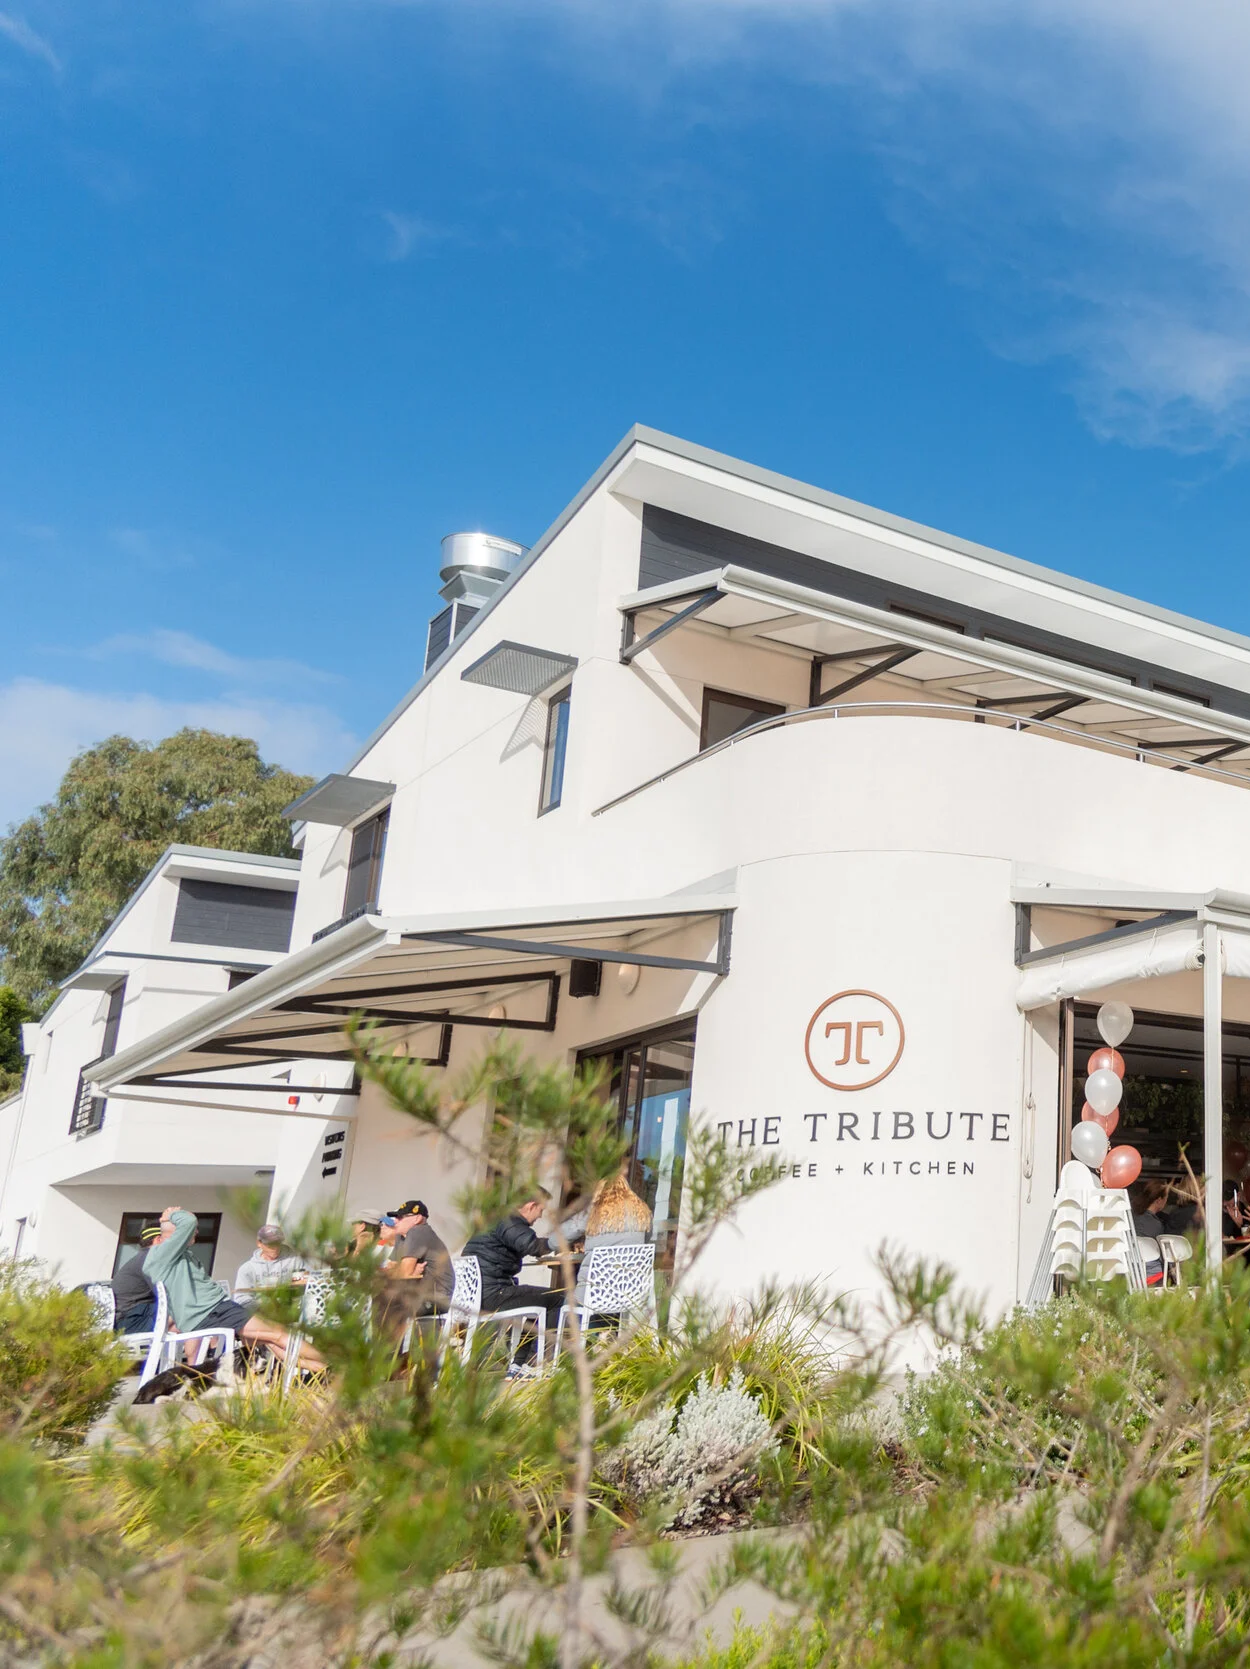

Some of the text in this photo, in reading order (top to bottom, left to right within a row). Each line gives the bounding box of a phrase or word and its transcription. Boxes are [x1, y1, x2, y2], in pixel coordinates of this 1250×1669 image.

[717, 1111, 1011, 1150] THE TRIBUTE
[863, 1161, 975, 1176] KITCHEN
